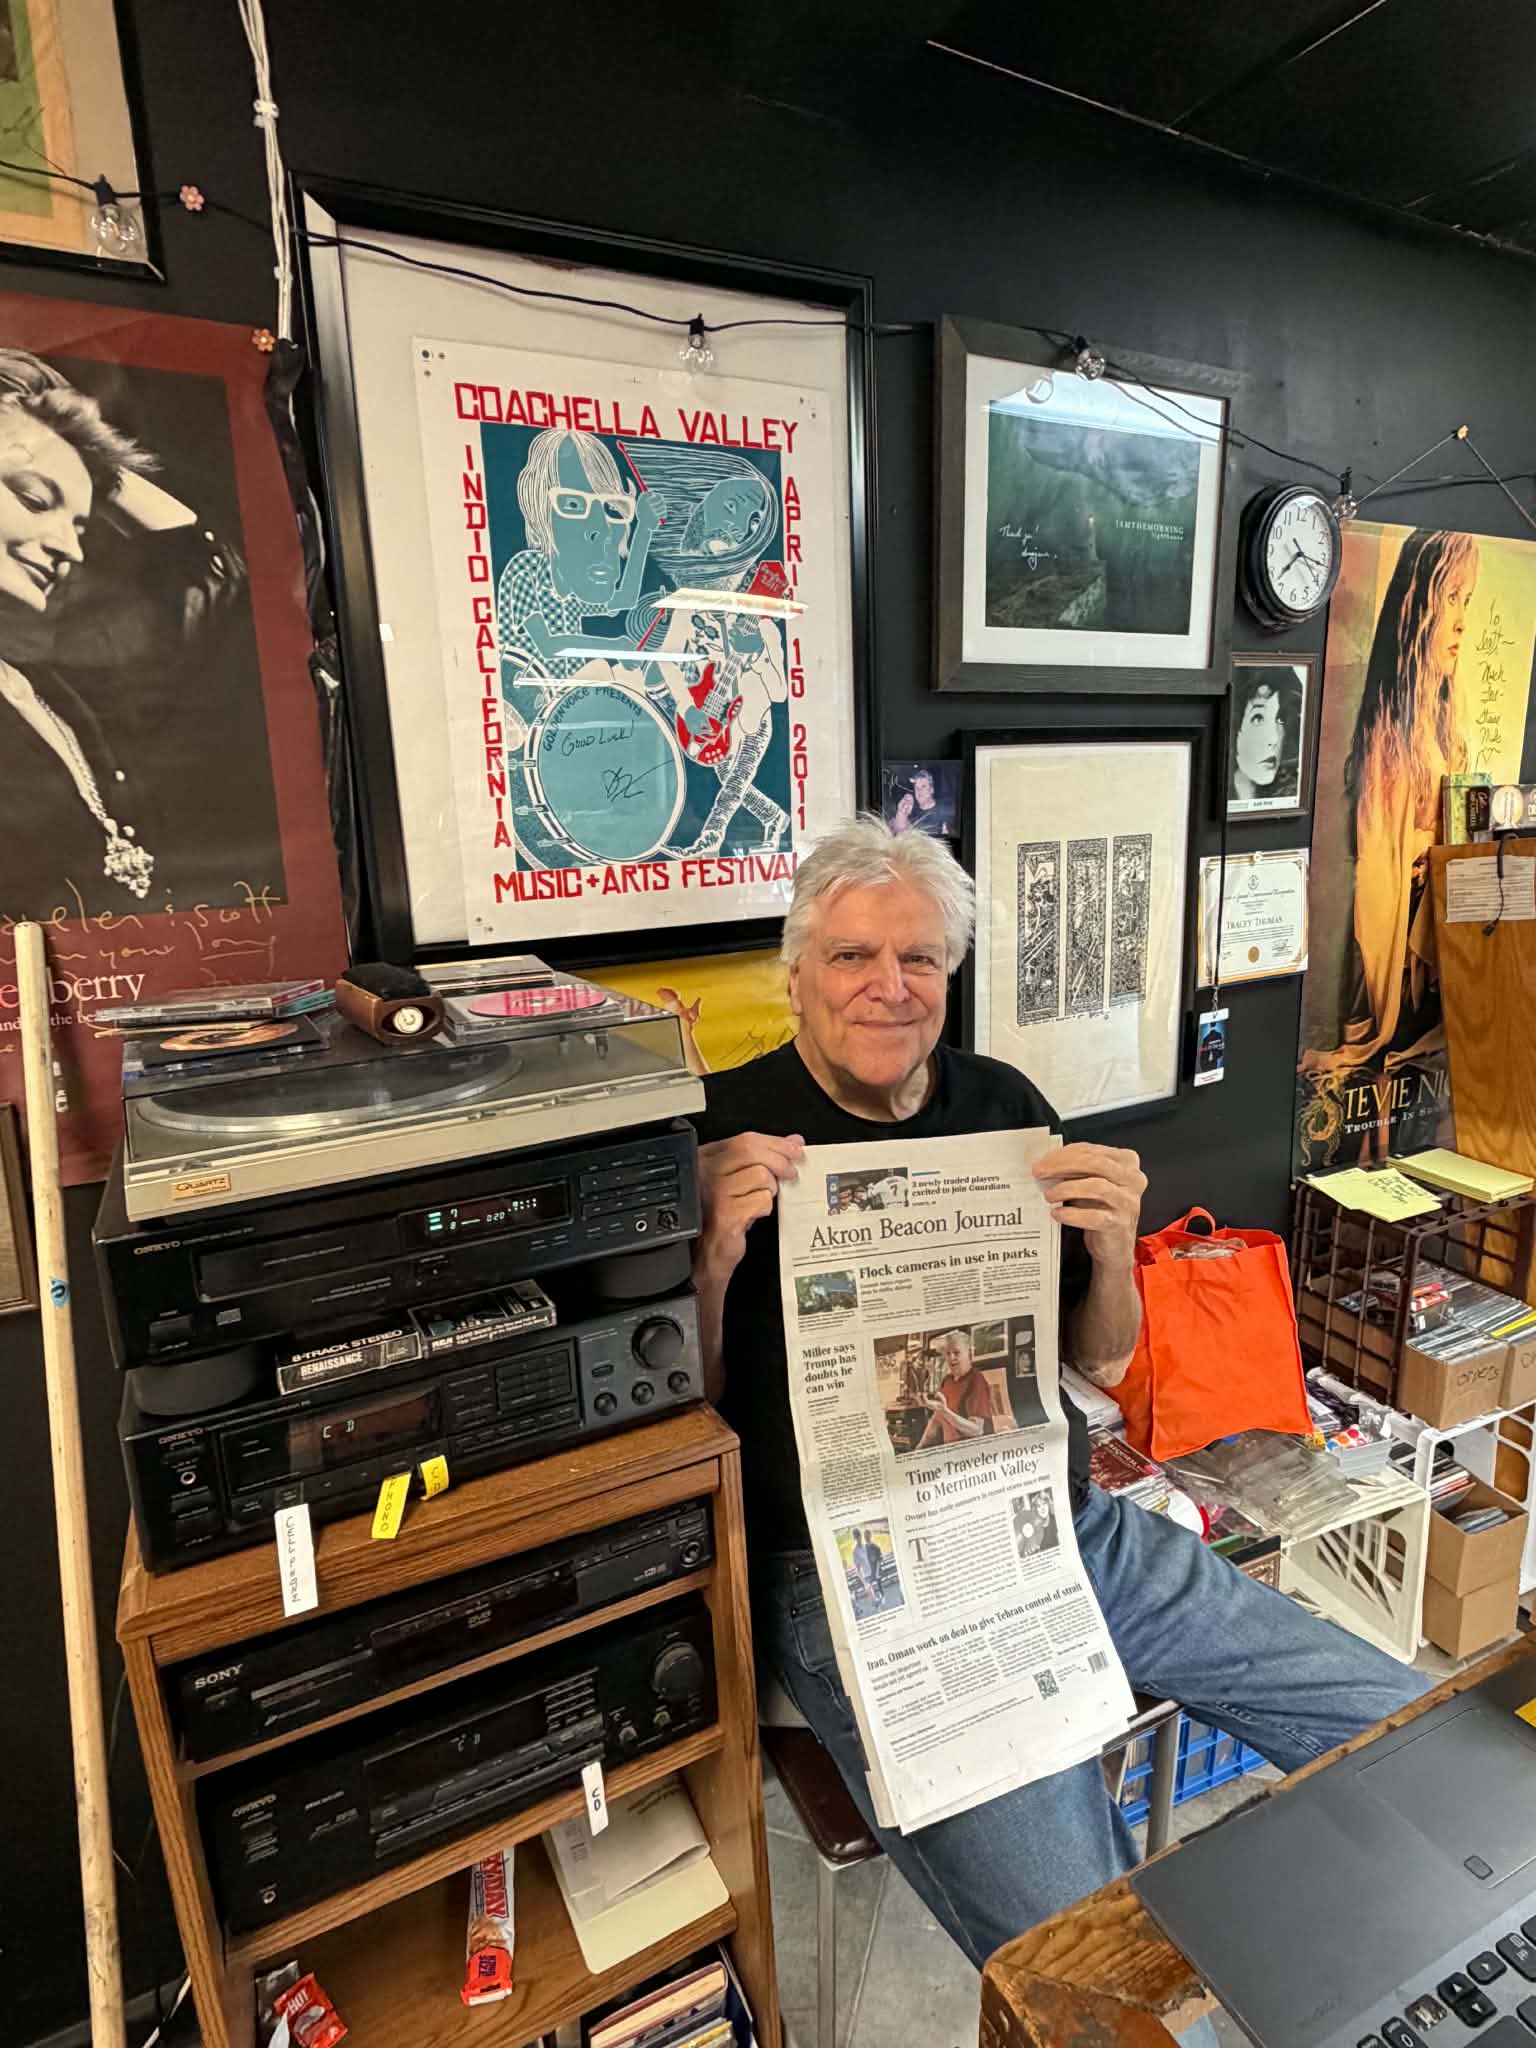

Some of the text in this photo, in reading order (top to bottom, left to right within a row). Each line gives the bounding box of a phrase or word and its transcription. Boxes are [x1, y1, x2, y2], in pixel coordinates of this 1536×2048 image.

[453, 382, 799, 454] COACHELLA VALLEY
[1273, 526, 1282, 540] 10
[1284, 511, 1292, 526] 11
[1290, 588, 1297, 601] 6
[462, 444, 512, 849] INDIO CALIFORNIA
[790, 638, 805, 699] 15
[595, 685, 642, 717] PRESENTS
[792, 723, 808, 831] 2011
[809, 1207, 1023, 1249] Akron Beacon Journal
[133, 1239, 181, 1256] ONKYO
[859, 1246, 1038, 1279] Flock cameras in use in parks
[291, 1328, 404, 1363] 8-TRACK STEREO
[802, 1343, 855, 1359] Miller says
[300, 1350, 364, 1378] RENAISSANCE
[803, 1354, 857, 1371] Trump has
[804, 1366, 853, 1383] doubts he
[806, 1379, 845, 1395] can win
[157, 1426, 205, 1445] ONKYO
[904, 1440, 1046, 1487] Time Traveler moves
[916, 1489, 932, 1504] to
[934, 1469, 998, 1500] Merriman
[1000, 1457, 1040, 1478] Valley
[866, 1657, 888, 1671] Iran,
[887, 1646, 917, 1664] Oman
[916, 1636, 939, 1653] work
[950, 1624, 968, 1639] deal
[968, 1622, 978, 1633] to
[978, 1616, 996, 1631] give
[994, 1605, 1025, 1622] Tehran
[1024, 1592, 1053, 1612] control
[1052, 1587, 1061, 1601] of
[1061, 1580, 1083, 1598] strait
[193, 1662, 244, 1689] SONY
